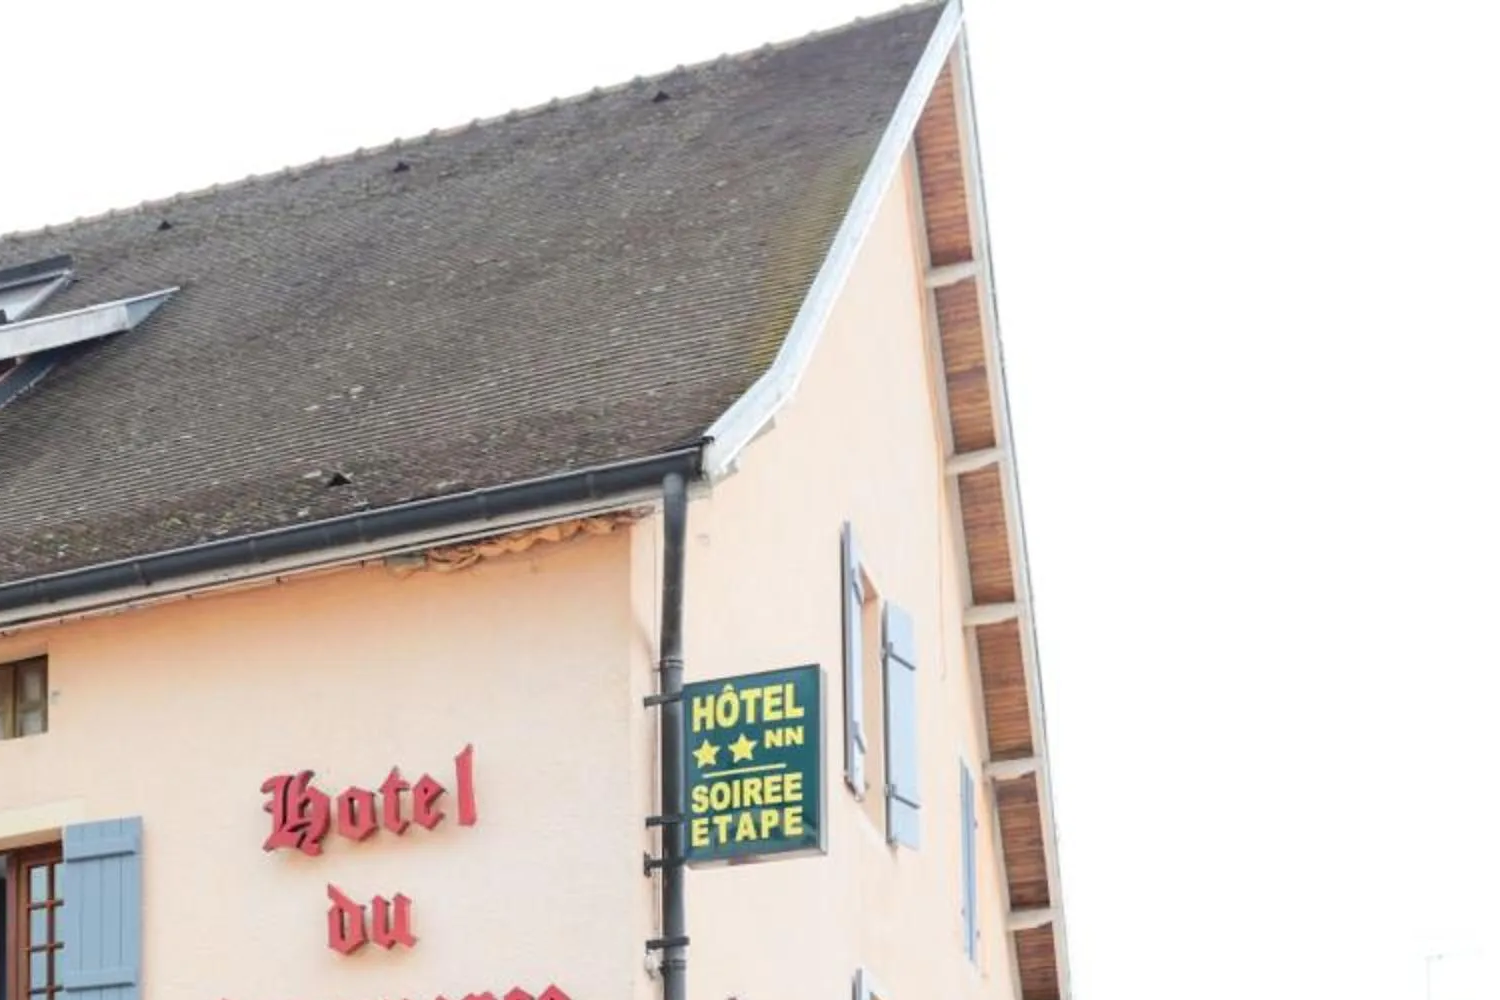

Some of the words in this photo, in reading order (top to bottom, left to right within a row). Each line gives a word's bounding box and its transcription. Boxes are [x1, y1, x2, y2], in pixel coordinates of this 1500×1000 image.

[692, 683, 805, 733] HÔTEL
[764, 725, 804, 749] NN
[261, 743, 477, 856] Hotel
[691, 771, 803, 814] SOIREE
[691, 805, 804, 847] ETAPE
[326, 882, 418, 956] du
